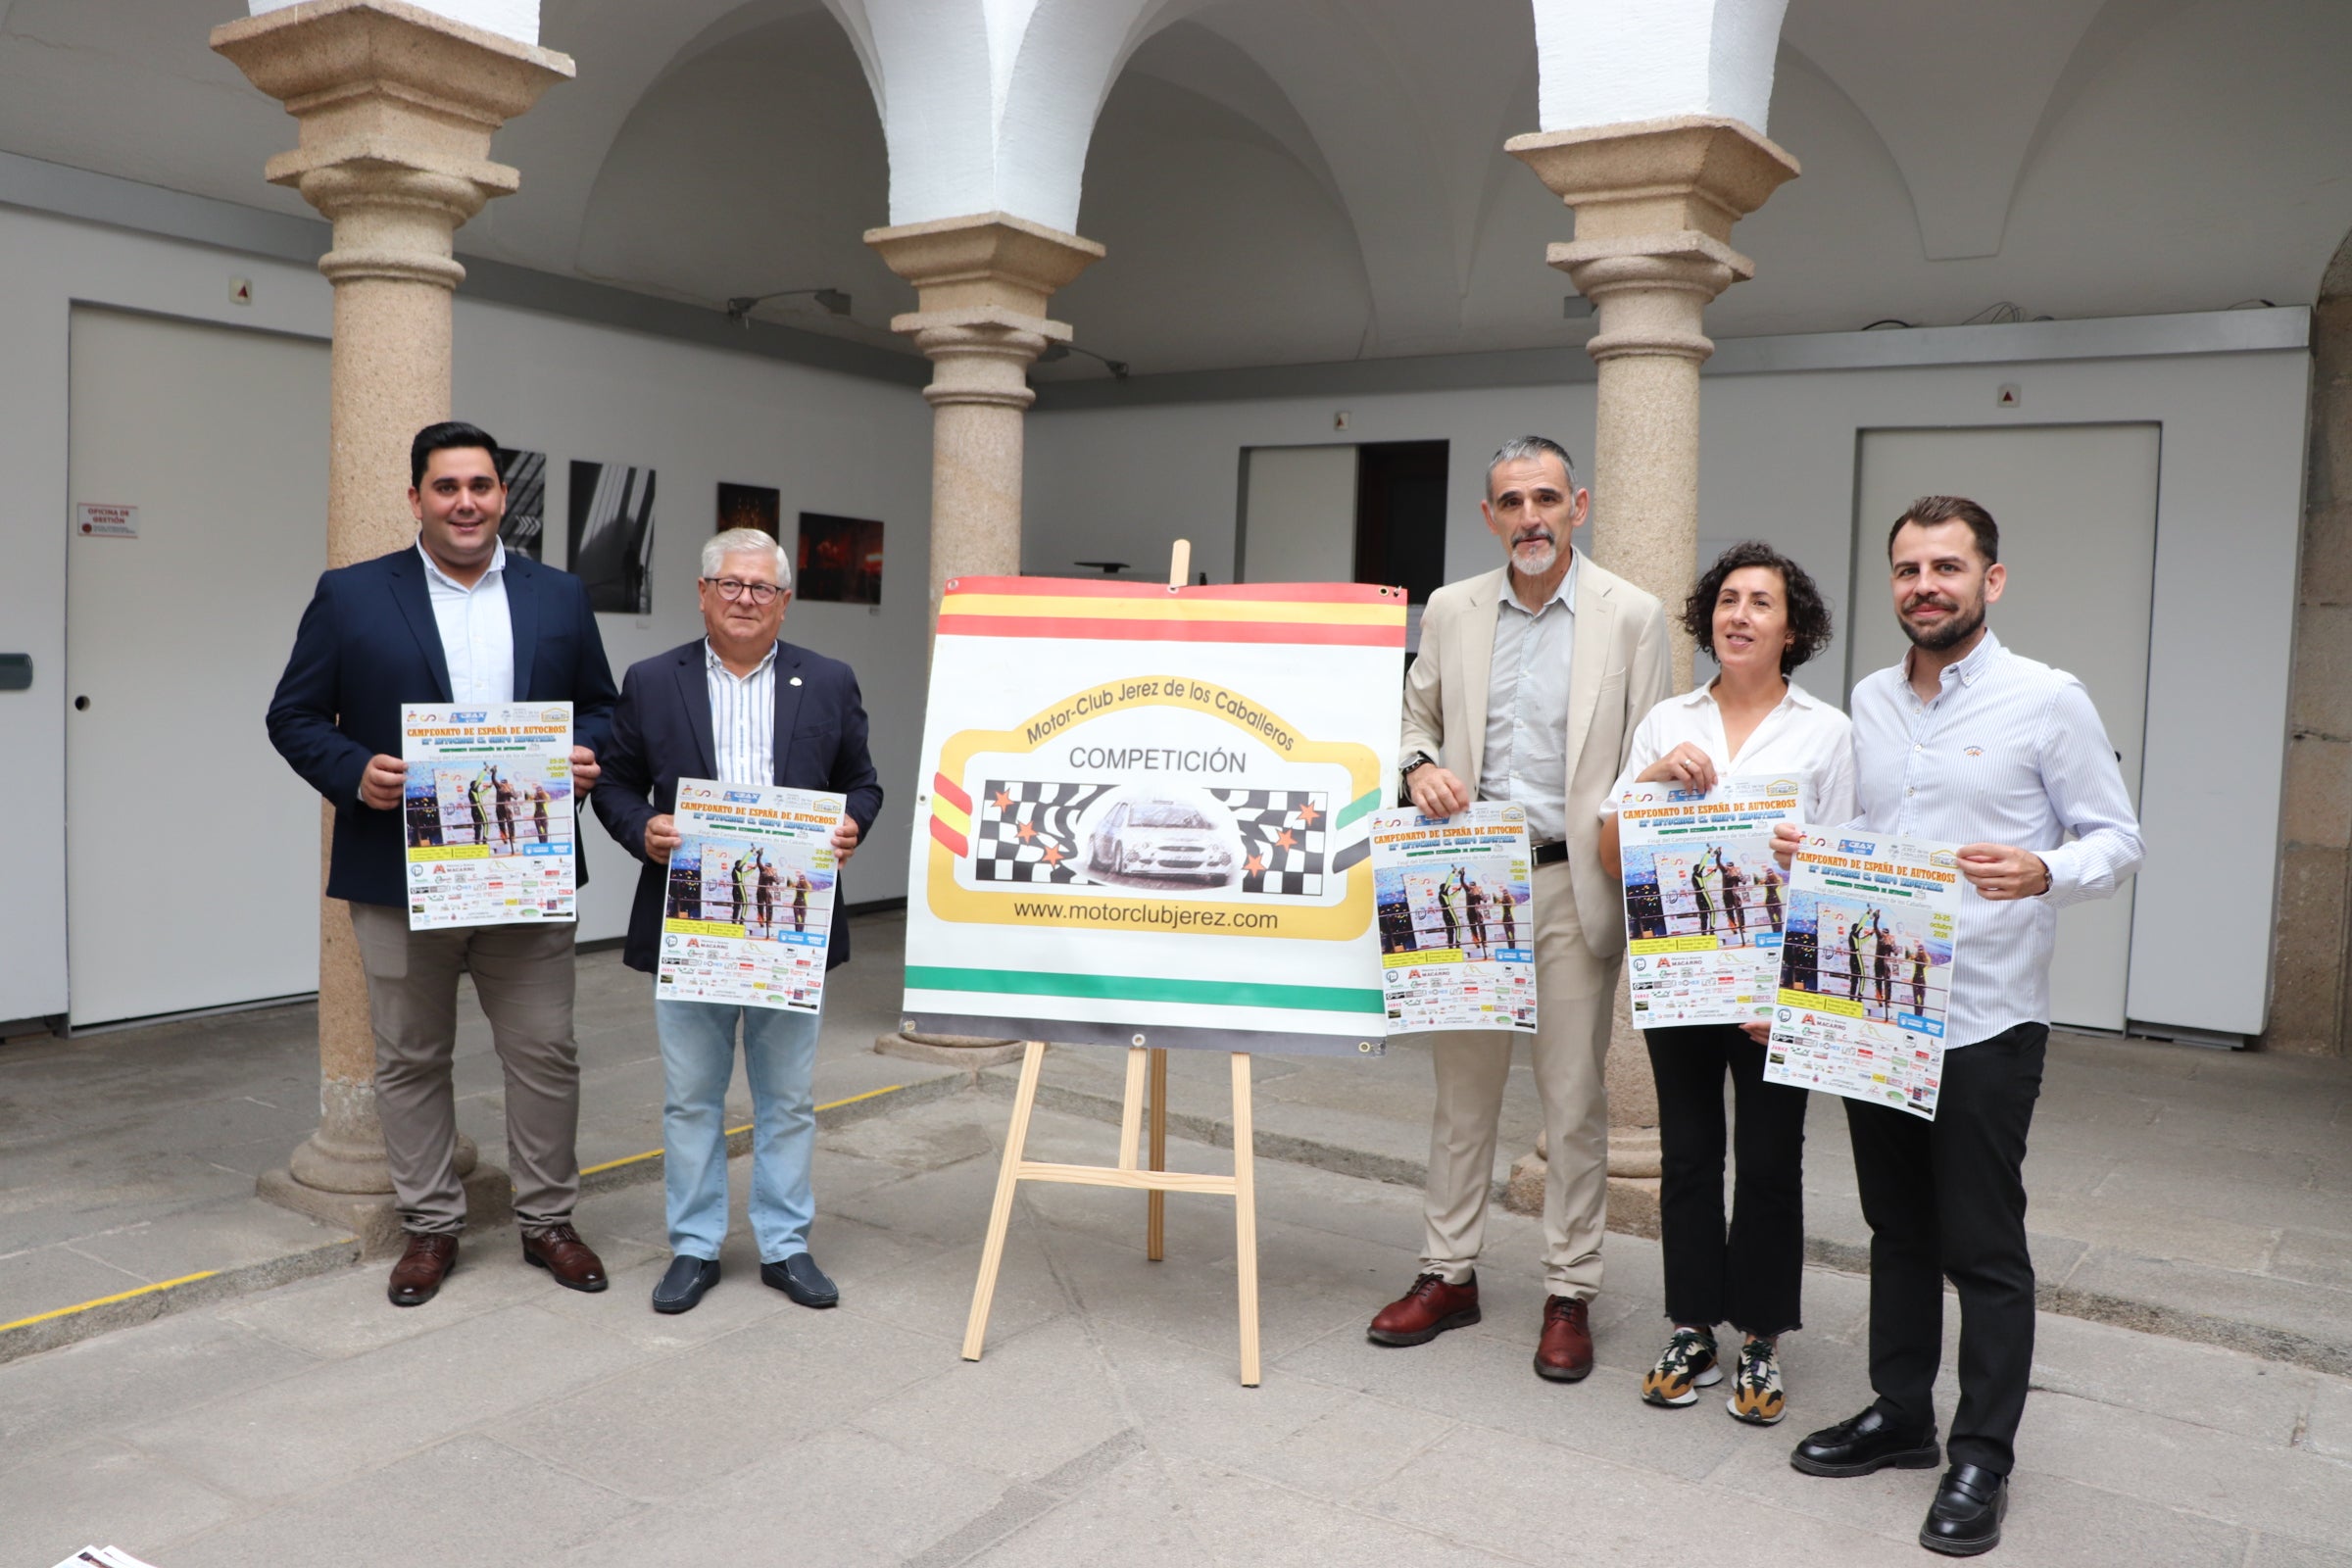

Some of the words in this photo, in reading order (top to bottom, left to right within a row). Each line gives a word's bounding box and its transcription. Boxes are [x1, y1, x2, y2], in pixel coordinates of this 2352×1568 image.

[1027, 690, 1113, 745] Motor-Club
[1118, 682, 1158, 702] Jerez
[1164, 679, 1184, 696] de
[1190, 682, 1211, 704] los
[1215, 691, 1294, 751] Caballeros
[408, 727, 461, 737] CAMPEONATO
[478, 725, 507, 735] ESPAÑA
[511, 726, 520, 735] DE
[523, 725, 566, 734] AUTOCROSS
[1069, 747, 1247, 773] COMPETICIÓN
[680, 802, 732, 814] CAMPEONATO
[736, 807, 746, 815] DE
[749, 808, 778, 819] ESPAÑA
[794, 813, 837, 825] AUTOCROSS
[1623, 807, 1680, 819] CAMPEONATO
[1684, 806, 1695, 815] DE
[1697, 802, 1731, 814] ESPAÑA
[1733, 802, 1744, 811] DE
[1748, 800, 1796, 809] AUTOCROSS
[1374, 831, 1426, 845] CAMPEONATO
[1429, 829, 1440, 838] DE
[1443, 826, 1472, 837] ESPAÑA
[1488, 825, 1523, 835] AUTOCROSS
[1796, 852, 1848, 868] CAMPEONATO
[1850, 858, 1860, 868] DE
[1864, 860, 1893, 874] ESPAÑA
[1897, 866, 1907, 876] DE
[1911, 868, 1956, 884] AUTOCROSS
[1014, 902, 1278, 929] www.motorclubjerez.com
